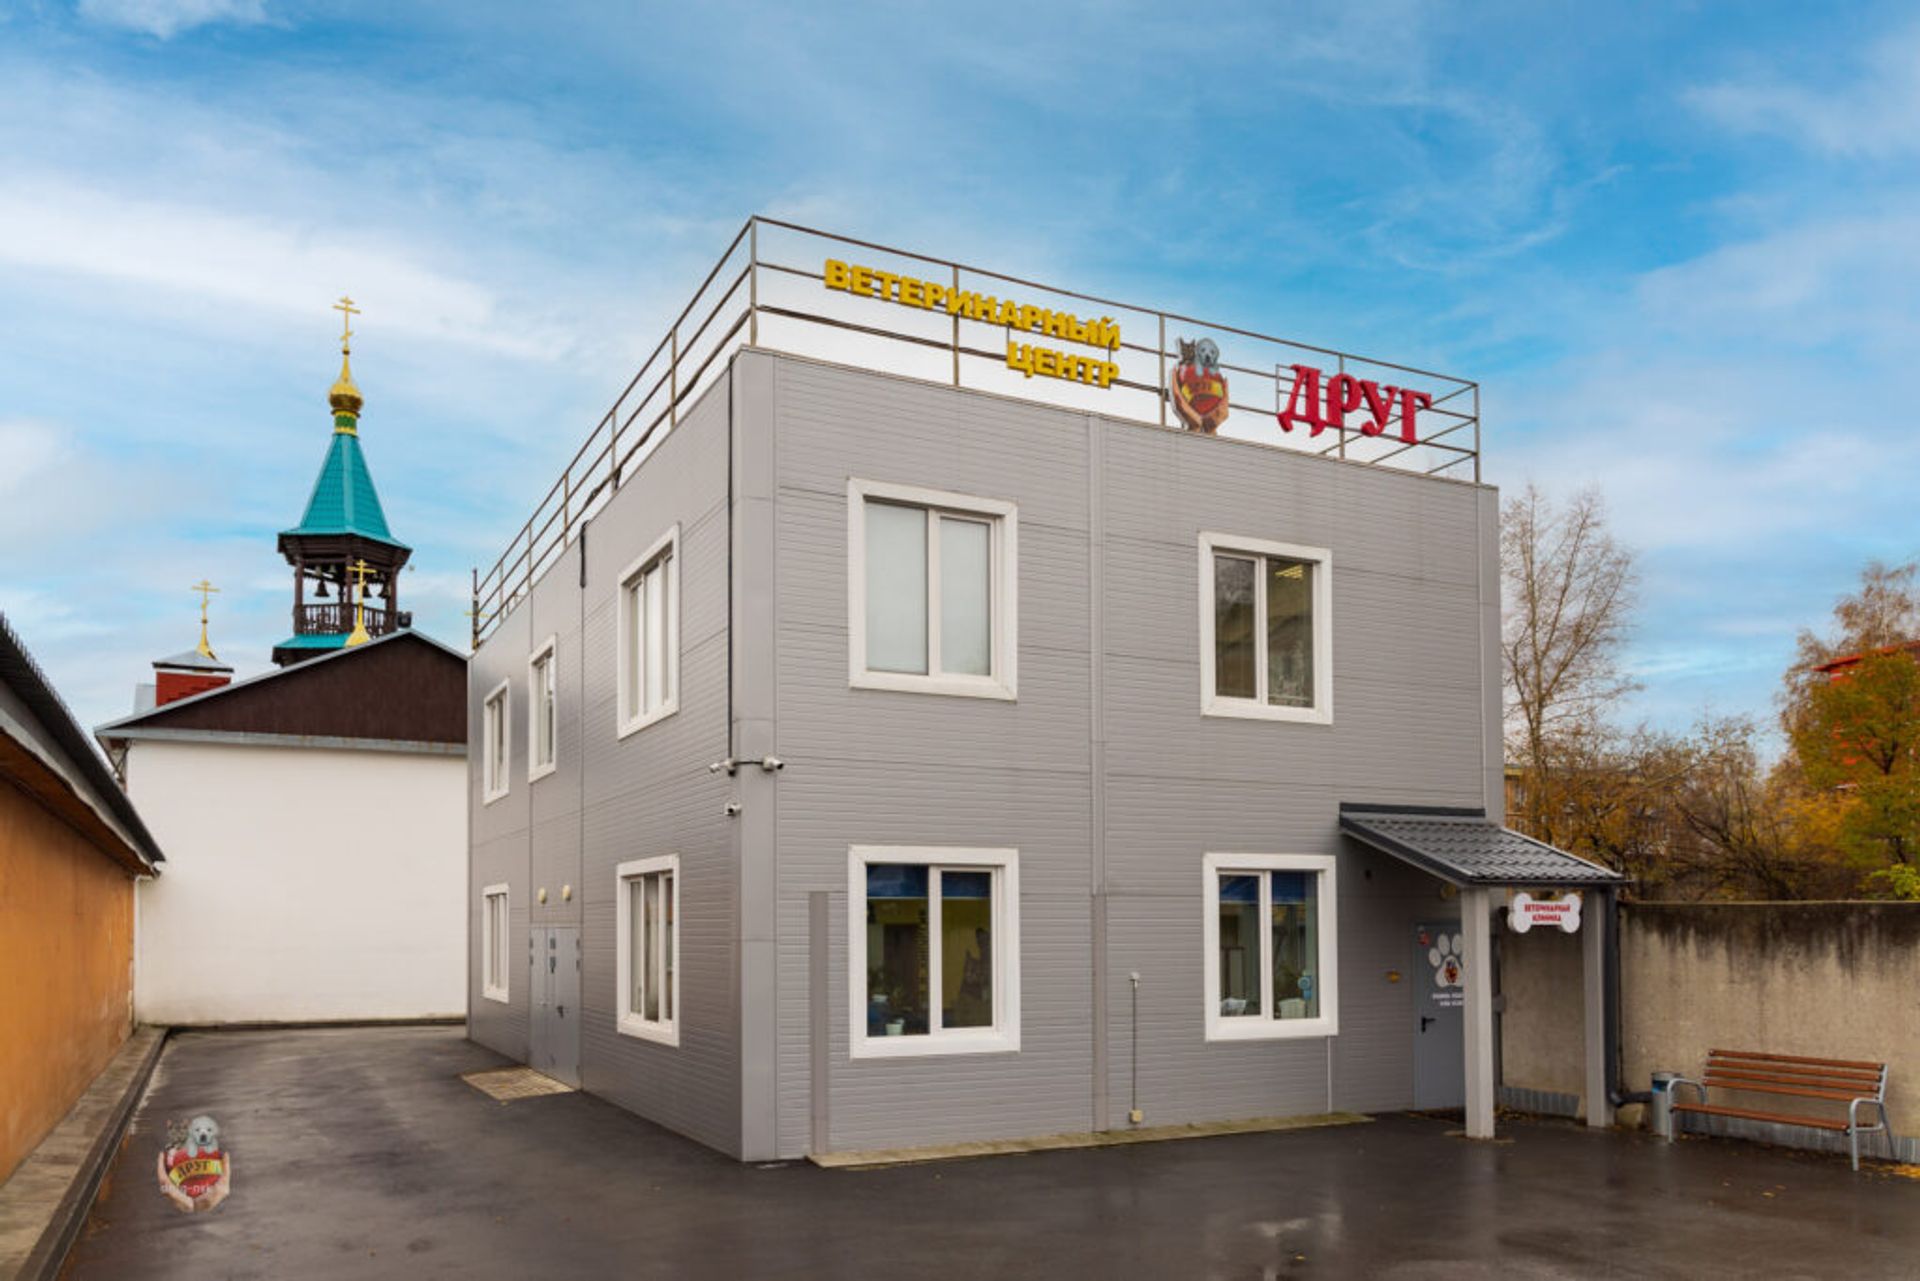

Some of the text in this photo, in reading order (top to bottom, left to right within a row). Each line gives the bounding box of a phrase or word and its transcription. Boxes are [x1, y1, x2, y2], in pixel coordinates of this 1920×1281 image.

[824, 258, 1121, 351] ВЕТЕРИНАРНЫЙ
[1006, 341, 1120, 389] ЦЕНТР
[1277, 364, 1432, 445] ДРУГ
